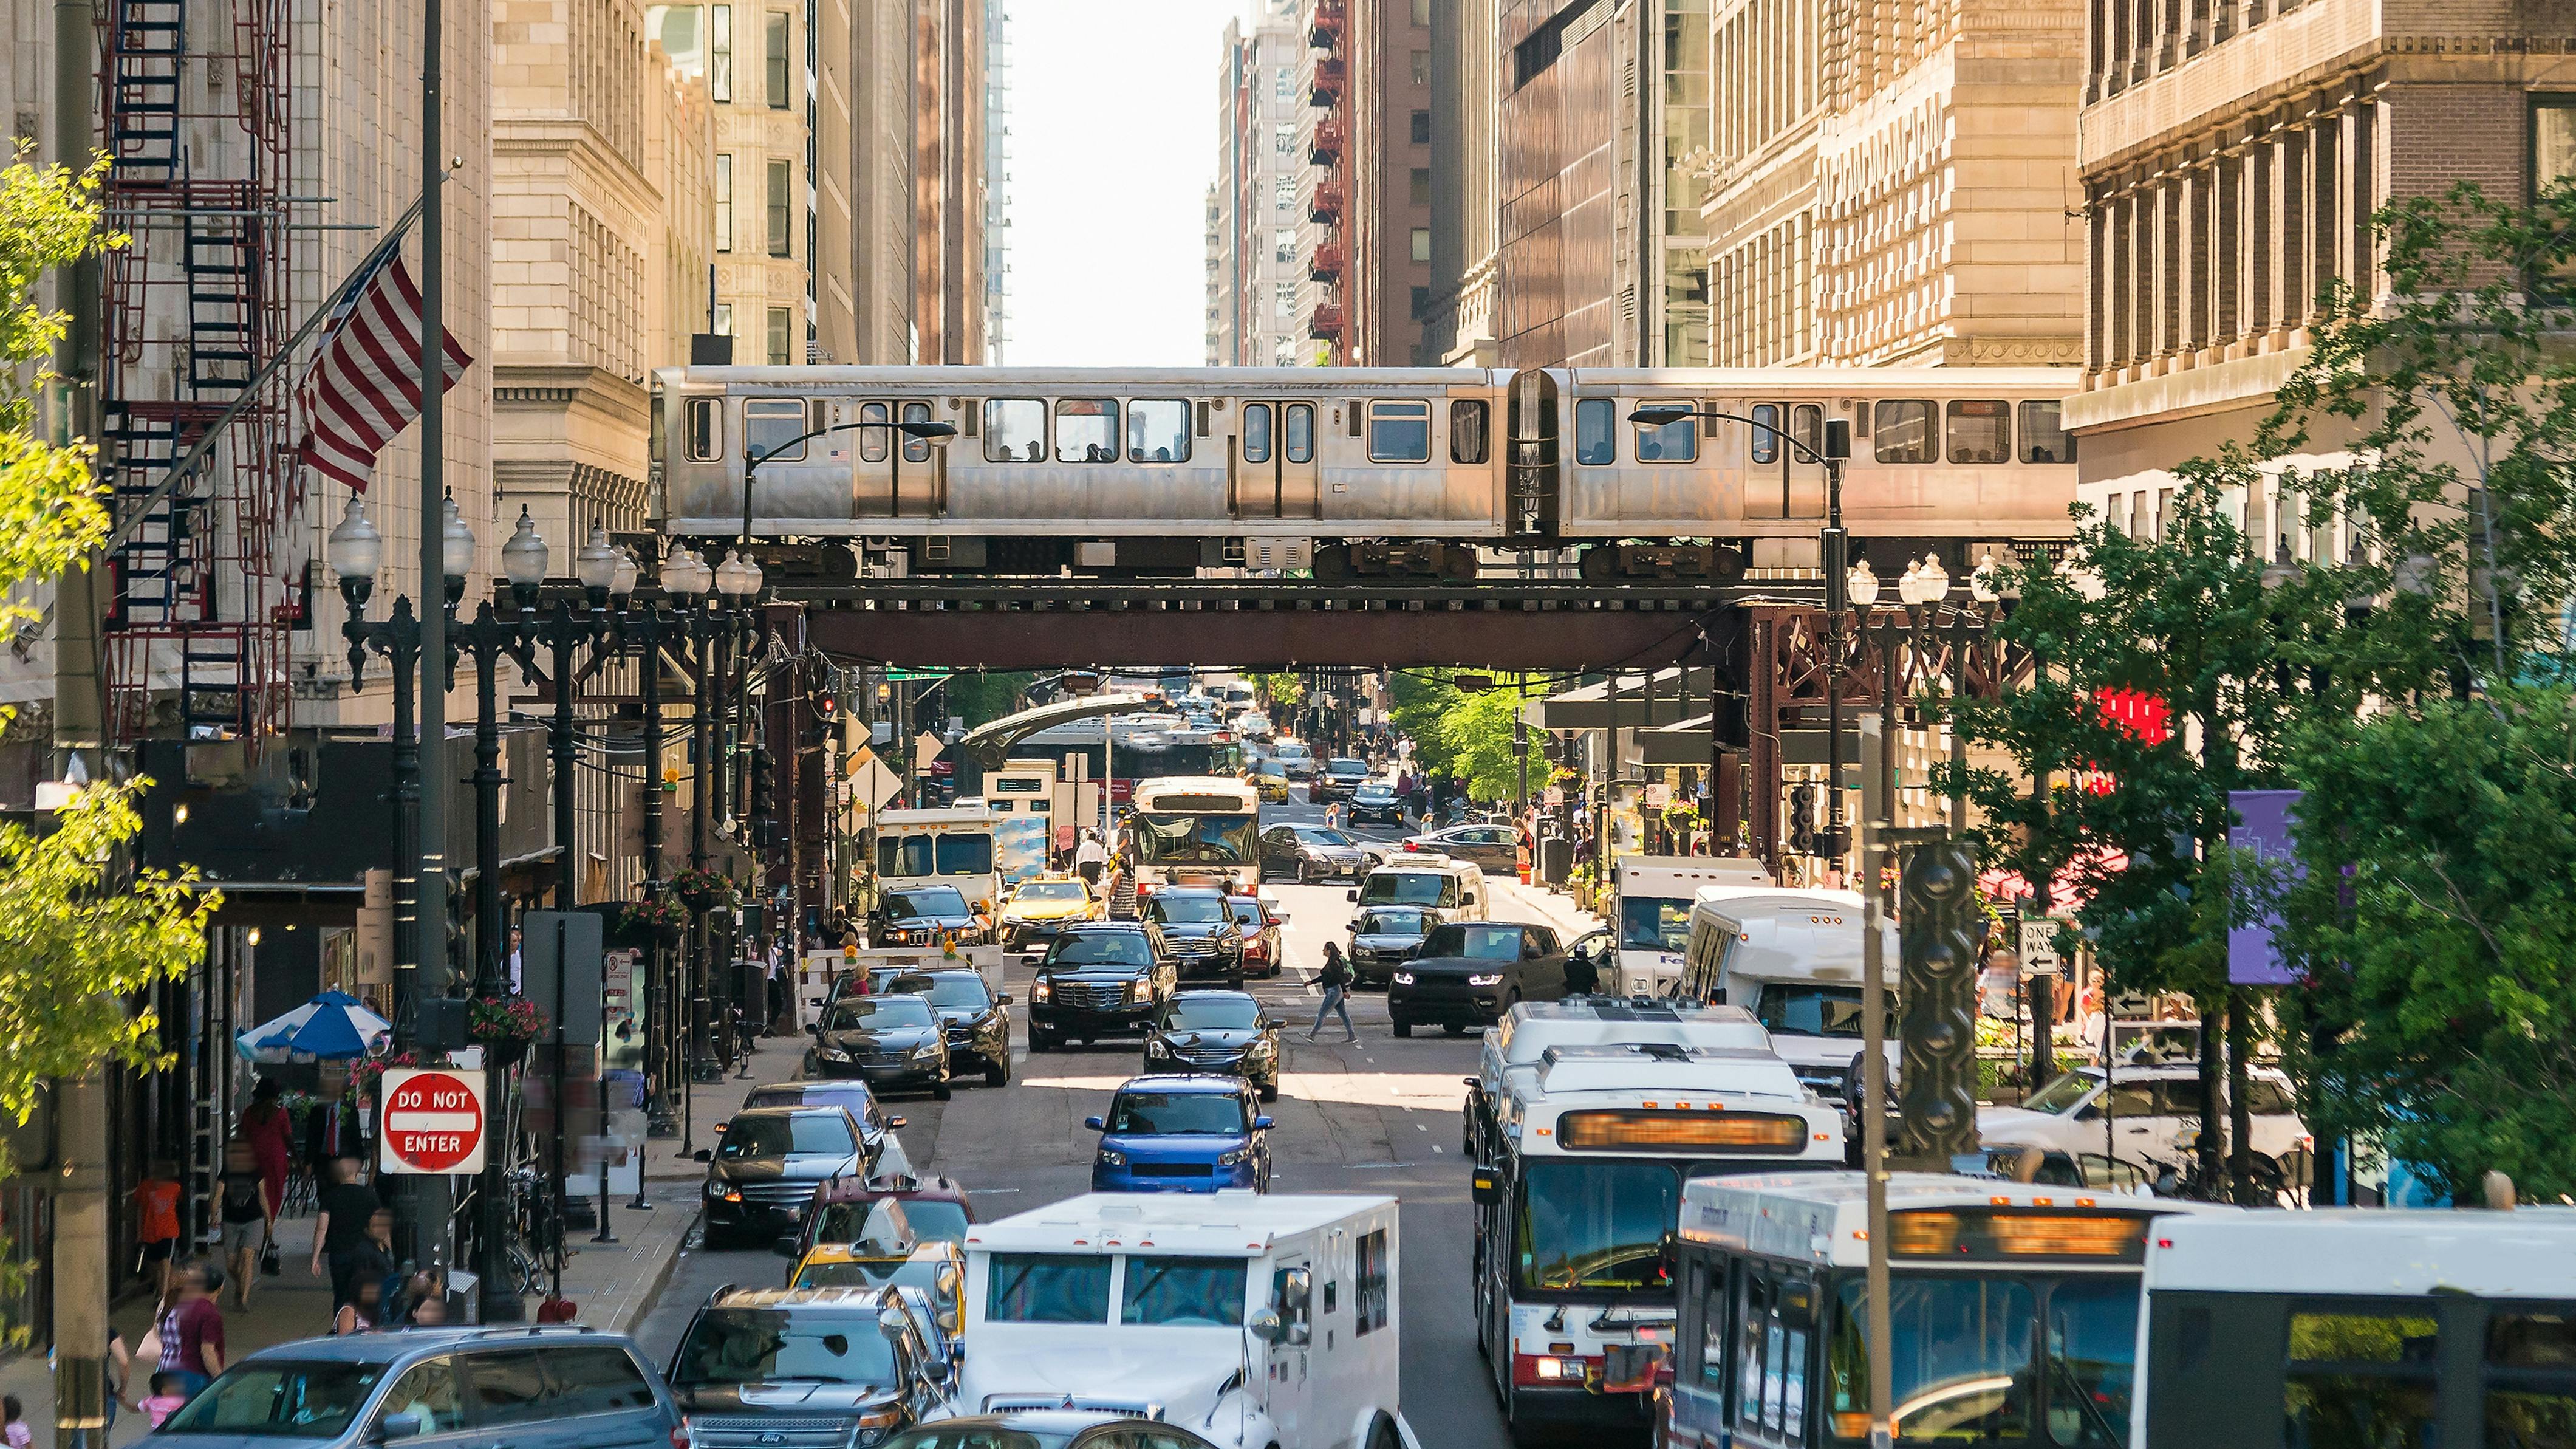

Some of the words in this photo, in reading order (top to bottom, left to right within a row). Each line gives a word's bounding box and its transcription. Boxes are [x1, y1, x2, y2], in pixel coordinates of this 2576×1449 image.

[2026, 926, 2054, 939] ONE
[2026, 941, 2053, 953] WAY
[398, 1091, 422, 1108] DO
[432, 1091, 469, 1109] NOT
[405, 1135, 460, 1153] ENTER
[761, 1434, 780, 1442] Ford
